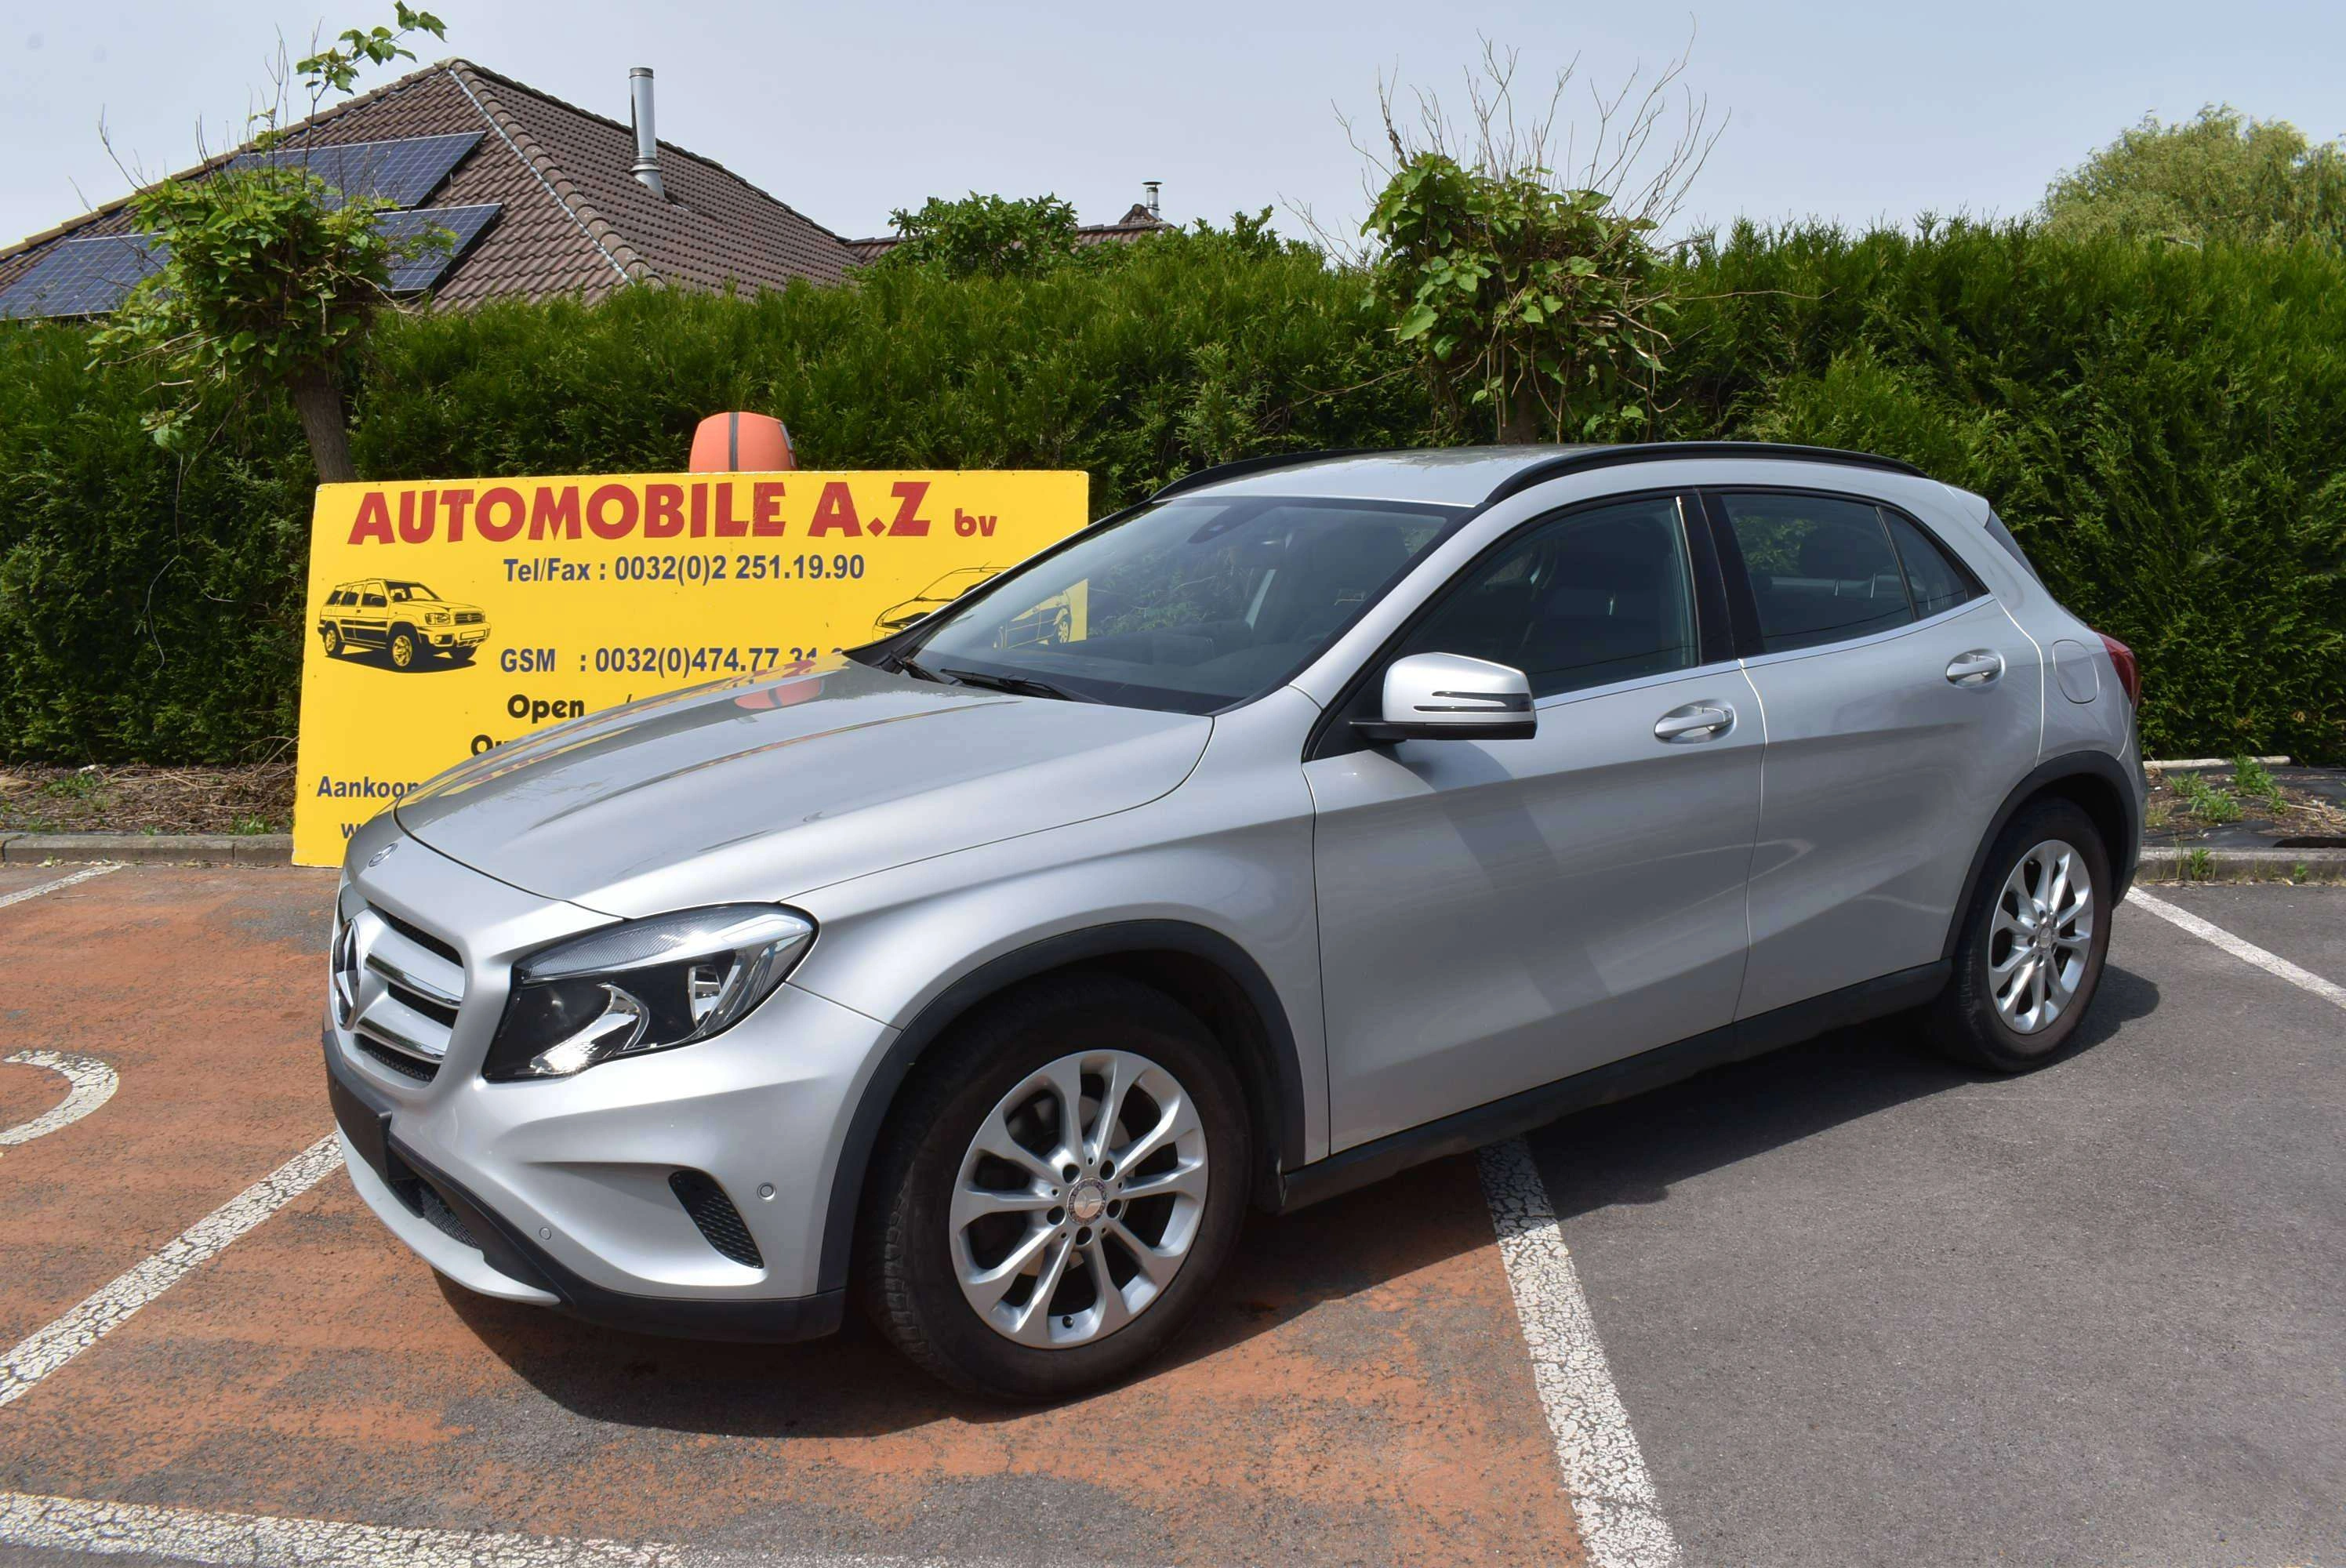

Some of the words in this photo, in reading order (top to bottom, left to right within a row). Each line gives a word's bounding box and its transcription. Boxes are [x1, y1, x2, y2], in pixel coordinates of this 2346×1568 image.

[347, 482, 786, 546] AUTOMOBILE
[807, 481, 932, 538] A.Z
[954, 507, 997, 538] bv
[503, 557, 590, 582] Tel/Fax
[615, 554, 727, 586] 0032(0)2
[735, 554, 865, 579] 251.19.90
[500, 648, 555, 673] GSM
[507, 694, 585, 724] Open
